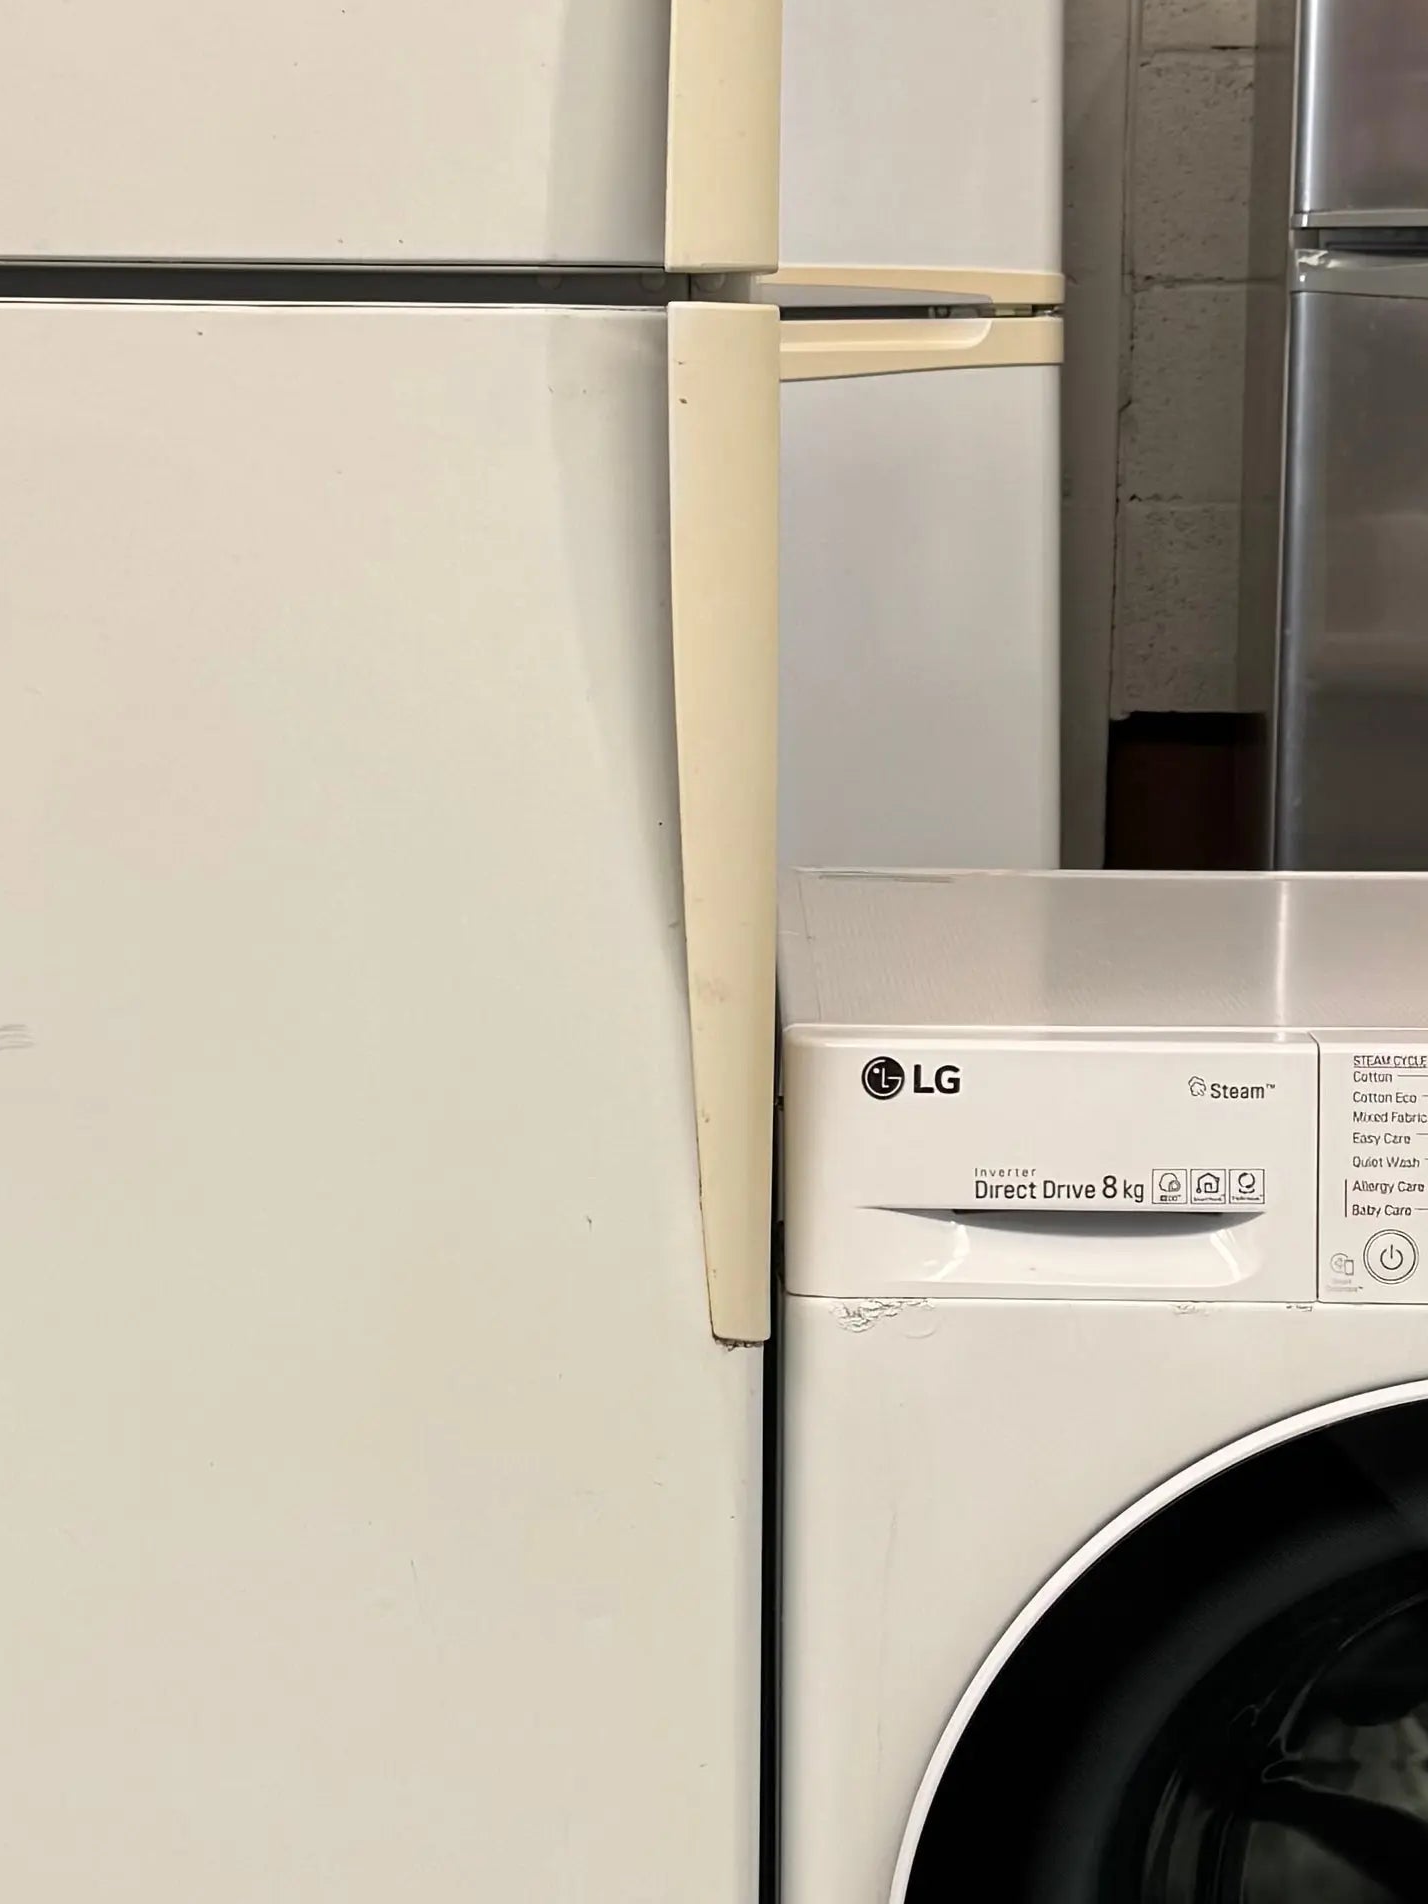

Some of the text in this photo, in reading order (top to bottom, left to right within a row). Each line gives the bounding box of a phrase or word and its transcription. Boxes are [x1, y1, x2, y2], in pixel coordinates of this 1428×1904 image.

[913, 1064, 961, 1094] LG
[1353, 1071, 1393, 1083] Cotton
[1353, 1092, 1417, 1104] Cotton Eco
[1353, 1111, 1427, 1123] Mixed Fabric
[1352, 1132, 1411, 1147] Easy Care
[1387, 1156, 1420, 1168] Wash
[975, 1168, 1037, 1178] Inverter
[975, 1176, 1145, 1203] Direct Drive 8 kg
[1352, 1180, 1425, 1195] Allergy Care
[1352, 1204, 1412, 1218] Baby Care
